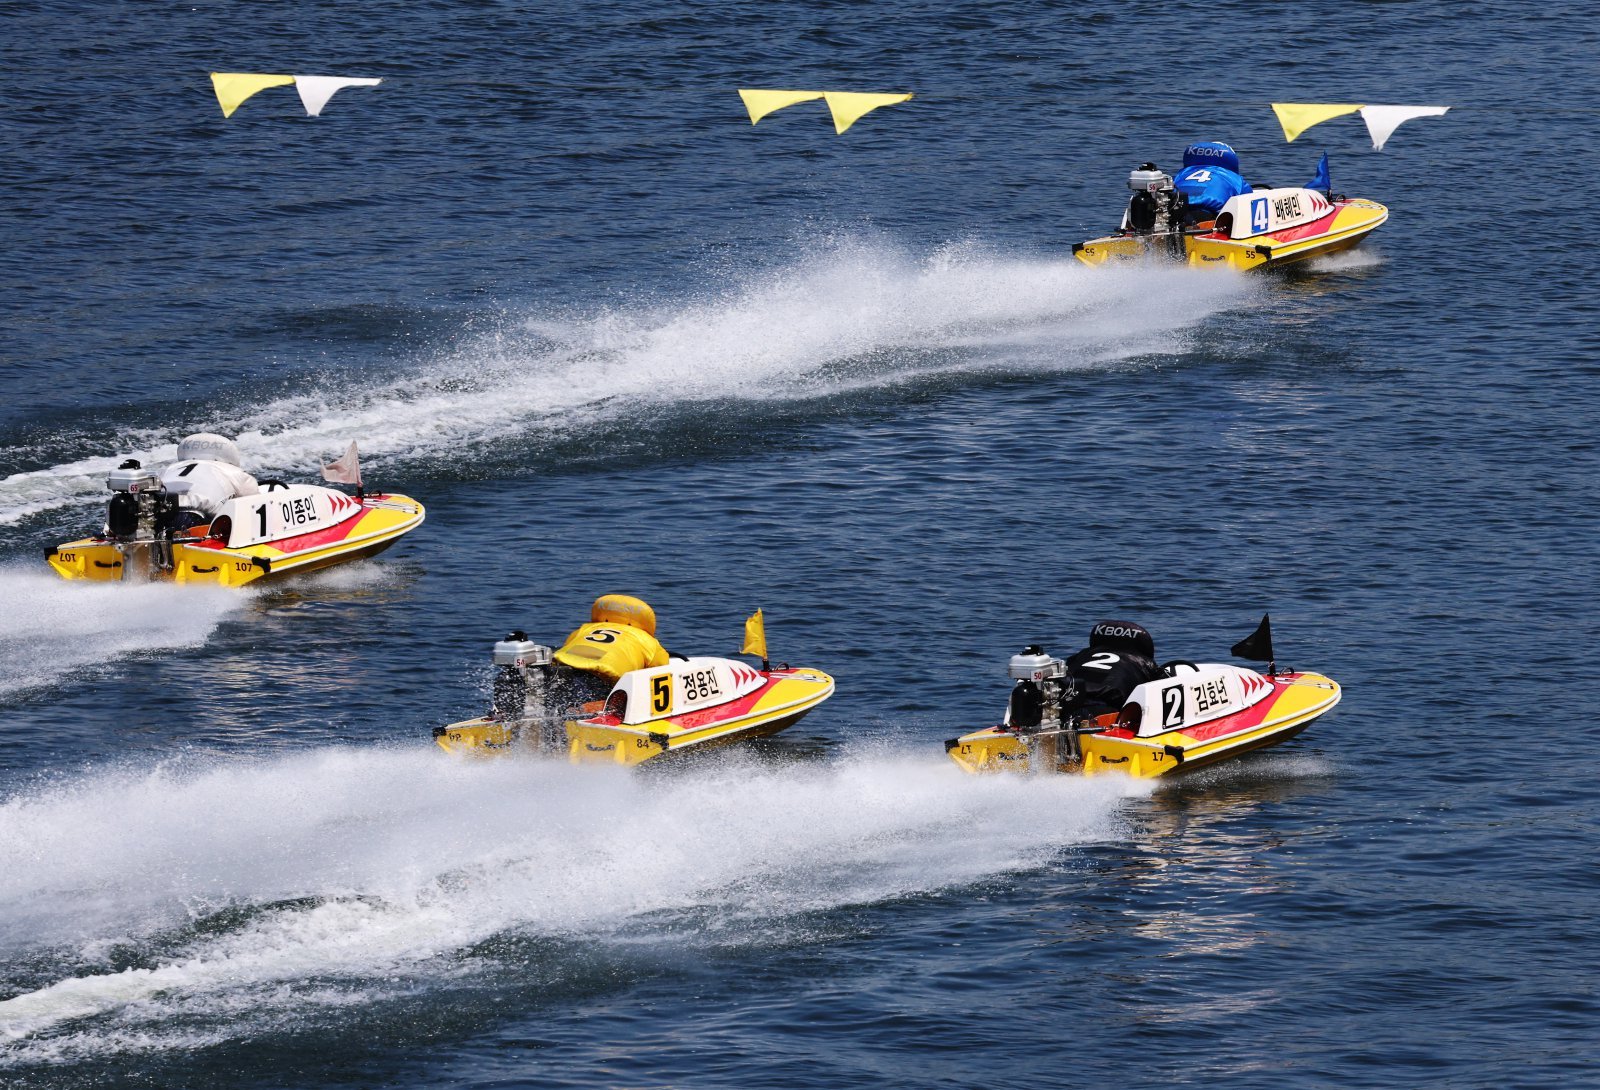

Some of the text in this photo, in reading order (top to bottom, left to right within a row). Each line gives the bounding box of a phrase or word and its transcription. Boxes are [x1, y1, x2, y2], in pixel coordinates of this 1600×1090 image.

[1188, 146, 1229, 157] KBOAT
[1185, 170, 1212, 182] 4
[1254, 200, 1268, 230] 4
[1246, 250, 1256, 259] 55
[178, 463, 198, 477] 1
[282, 496, 316, 525] 이종인
[256, 504, 267, 537] 1
[235, 562, 253, 572] 107
[585, 629, 621, 644] 5
[1094, 625, 1142, 638] KBOAT
[1082, 652, 1120, 670] 2
[683, 669, 719, 700] 정용진
[654, 676, 670, 712] 5
[1194, 678, 1228, 712] 김효년
[1166, 688, 1181, 727] 2
[636, 738, 649, 749] 84
[1152, 752, 1164, 761] 17
